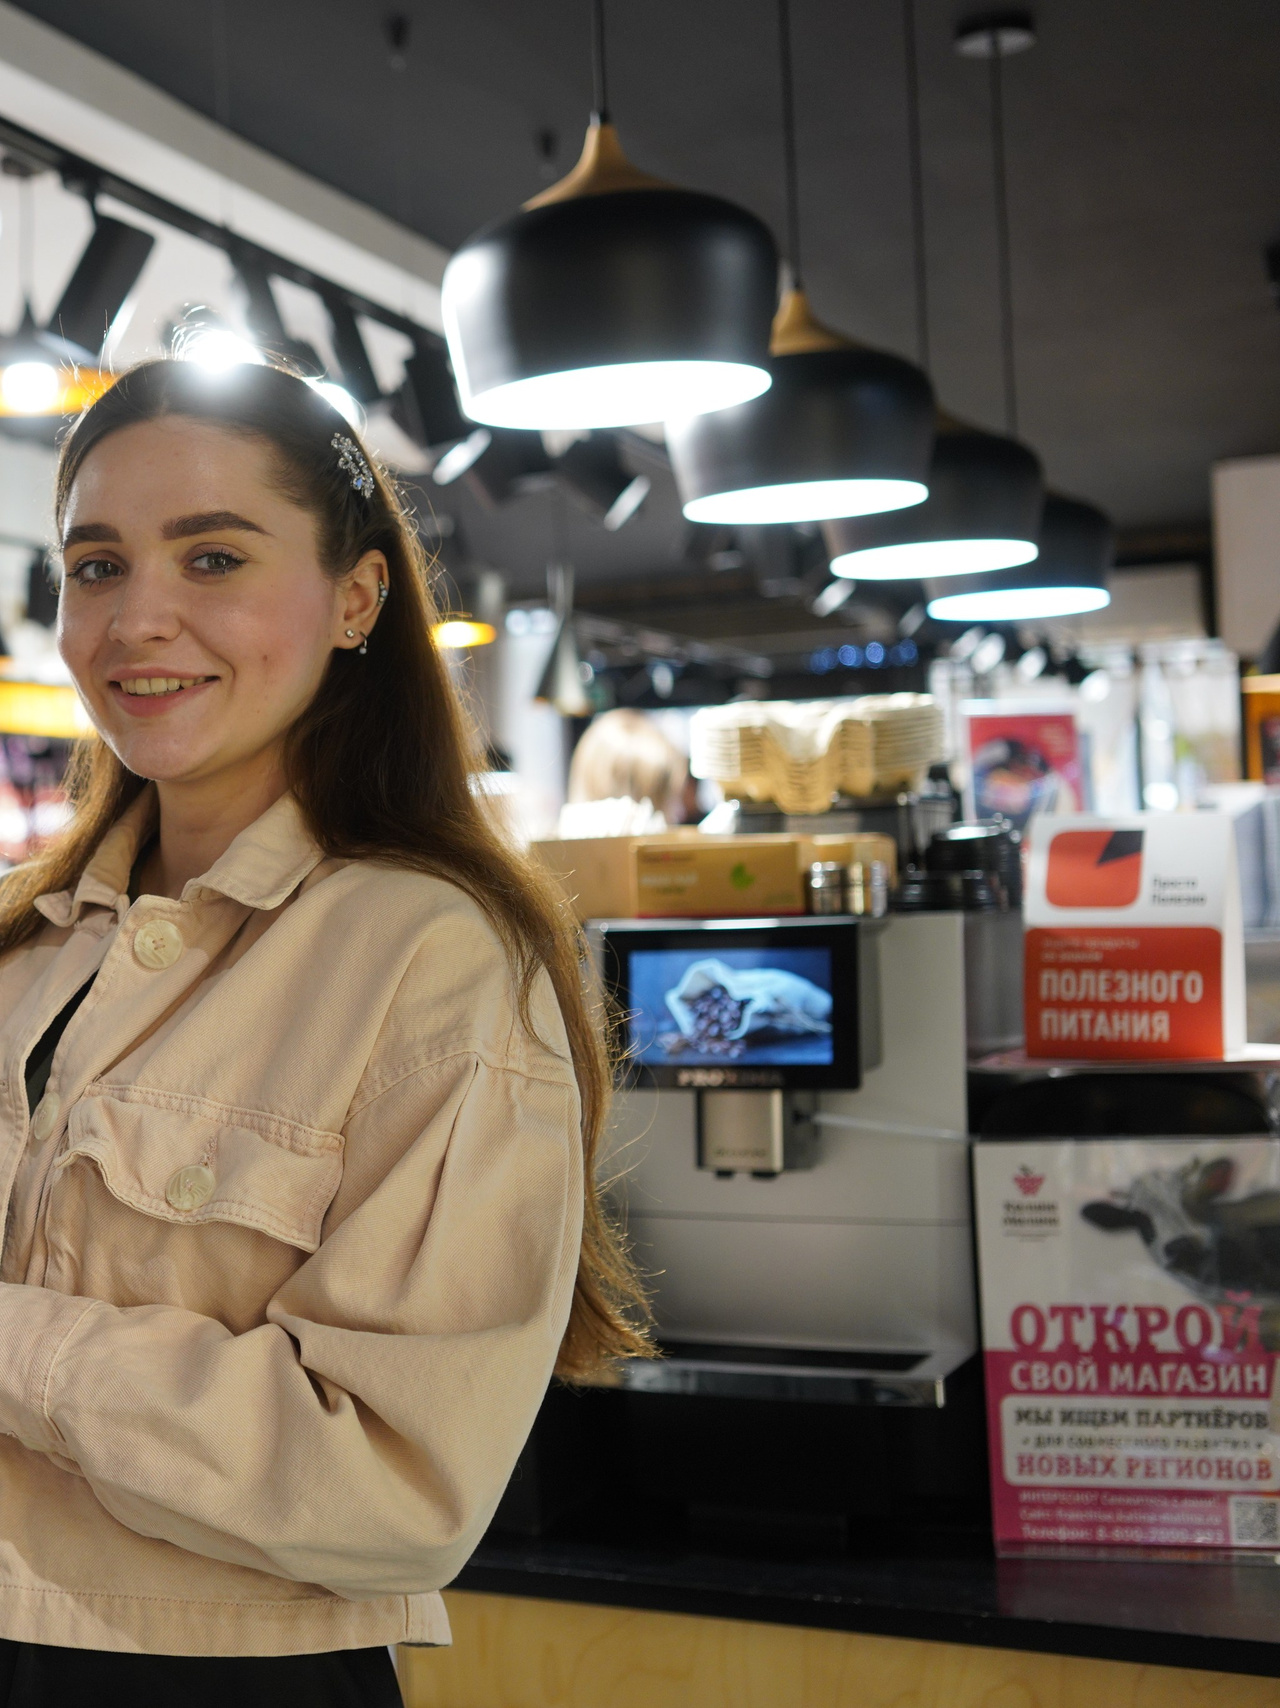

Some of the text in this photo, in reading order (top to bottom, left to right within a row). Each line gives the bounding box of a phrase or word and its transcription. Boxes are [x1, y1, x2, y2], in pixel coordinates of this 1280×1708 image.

[1039, 968, 1204, 1004] ПОЛЕЗНОГО
[1039, 1007, 1171, 1043] ПИТАНИЯ
[1009, 1289, 1266, 1352] ОТКРОЙ
[1009, 1356, 1267, 1394] СВОЙ МАГАЗИН
[1015, 1404, 1269, 1430] МЫ ИЩЕМ ПАРТНЁРОВ
[1016, 1453, 1273, 1481] НОВЫХ РЕГИОНОВ
